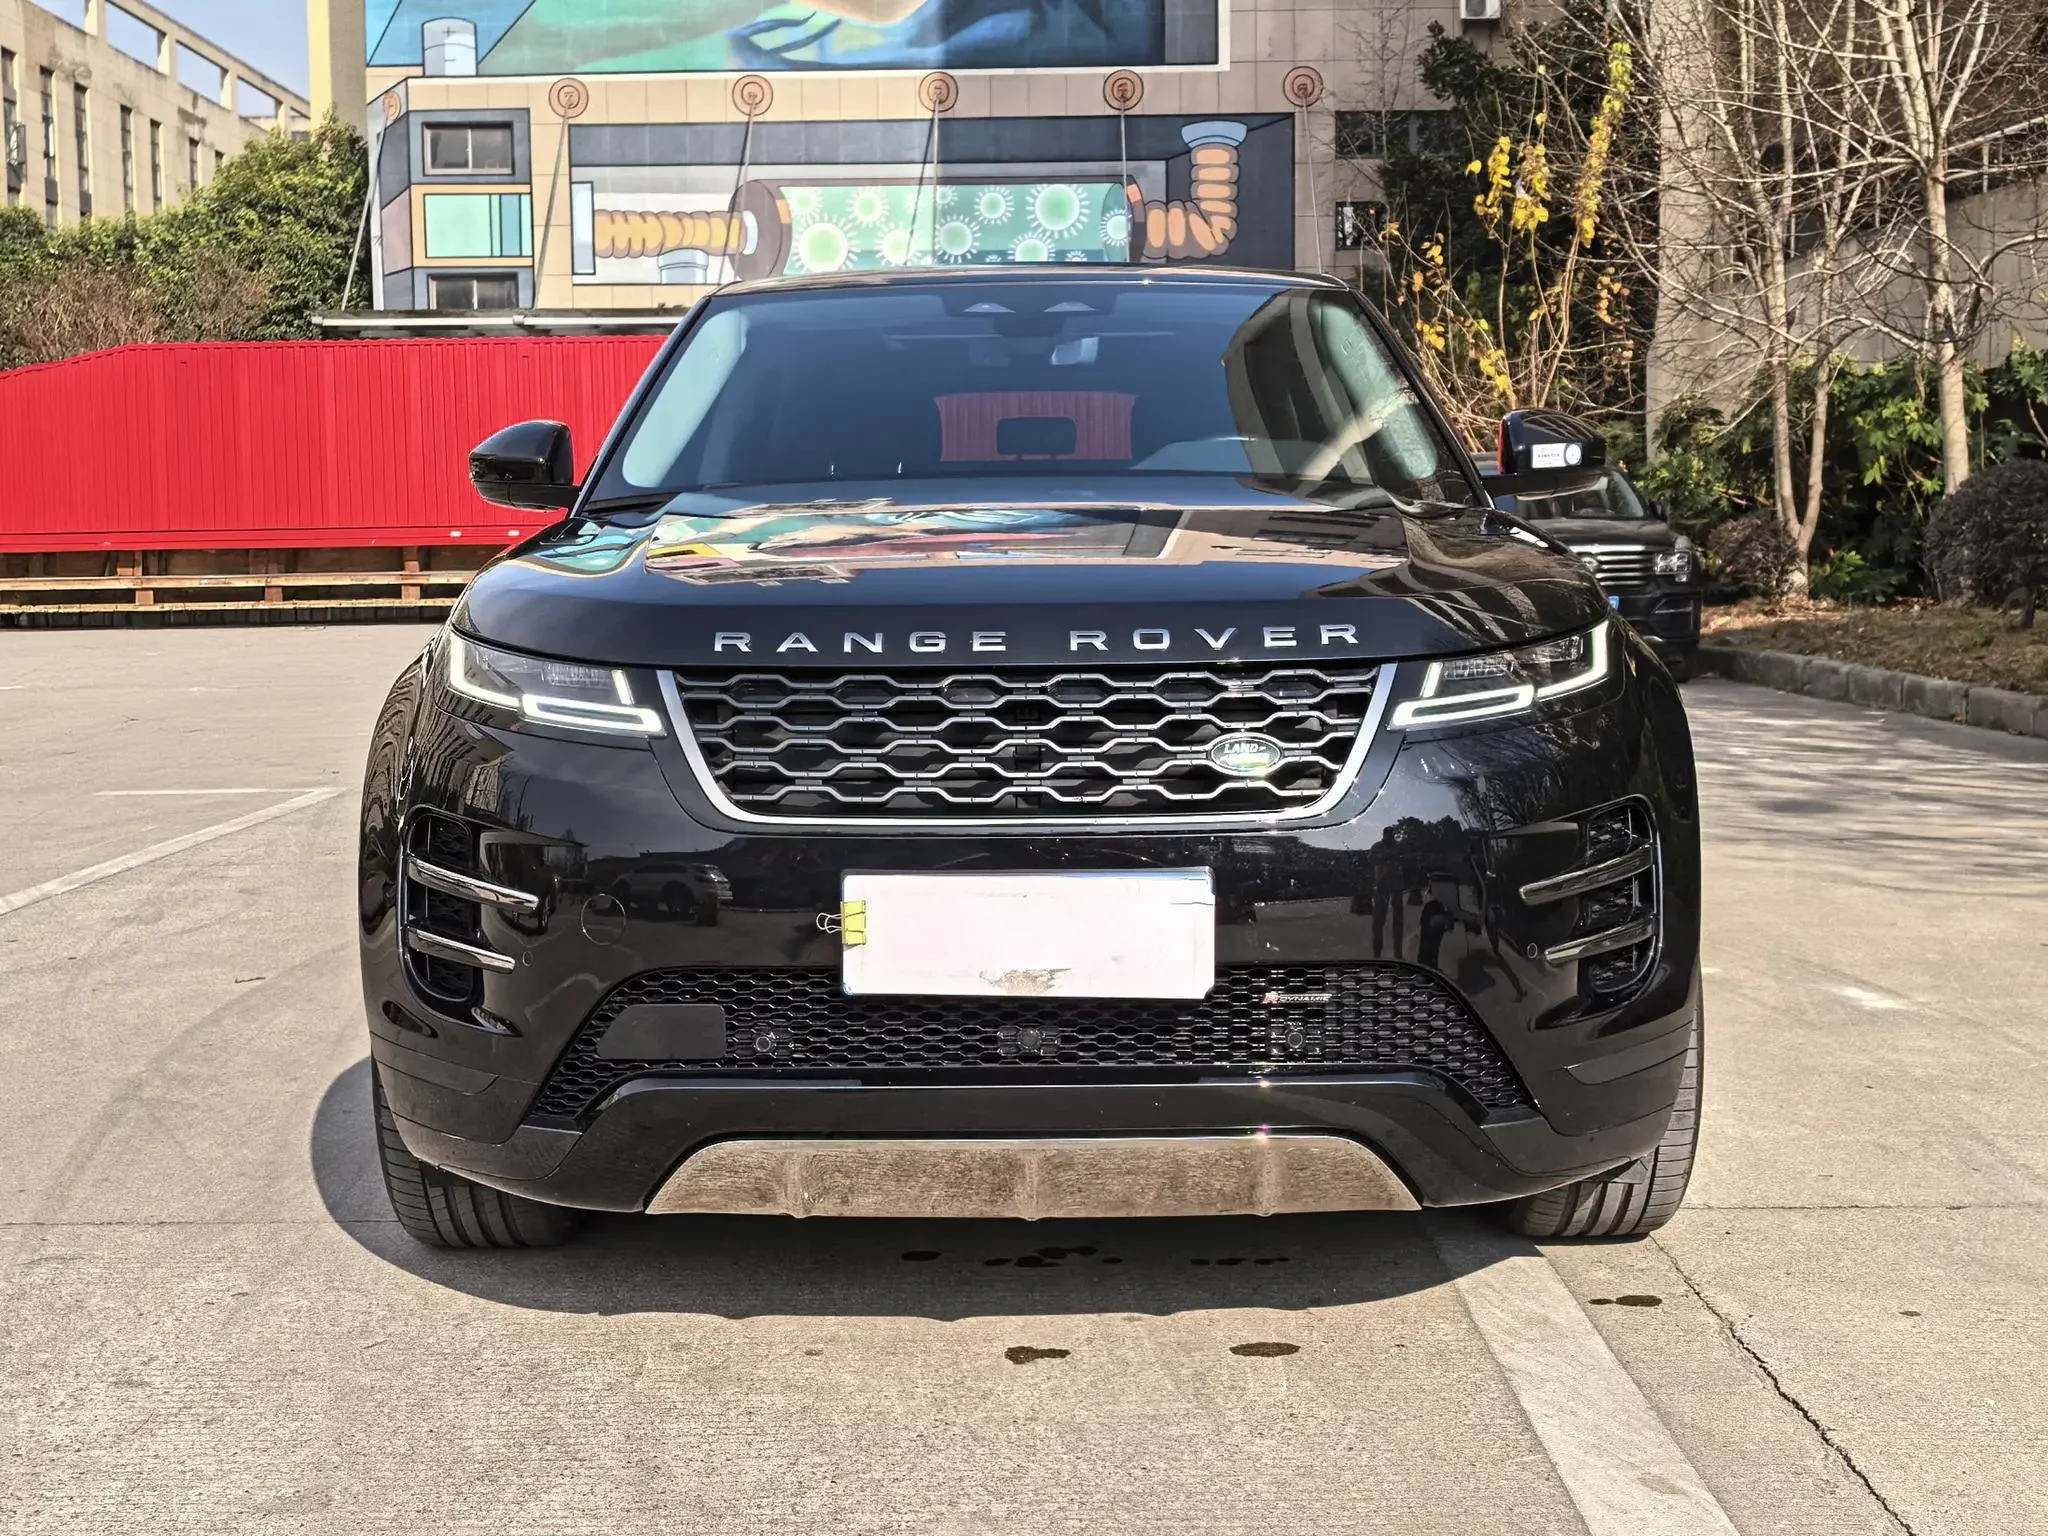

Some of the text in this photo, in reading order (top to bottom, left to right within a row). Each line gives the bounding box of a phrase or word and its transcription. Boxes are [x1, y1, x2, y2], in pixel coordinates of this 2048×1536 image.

[713, 623, 1359, 653] RANGE ROVER
[1223, 743, 1259, 754] LAND
